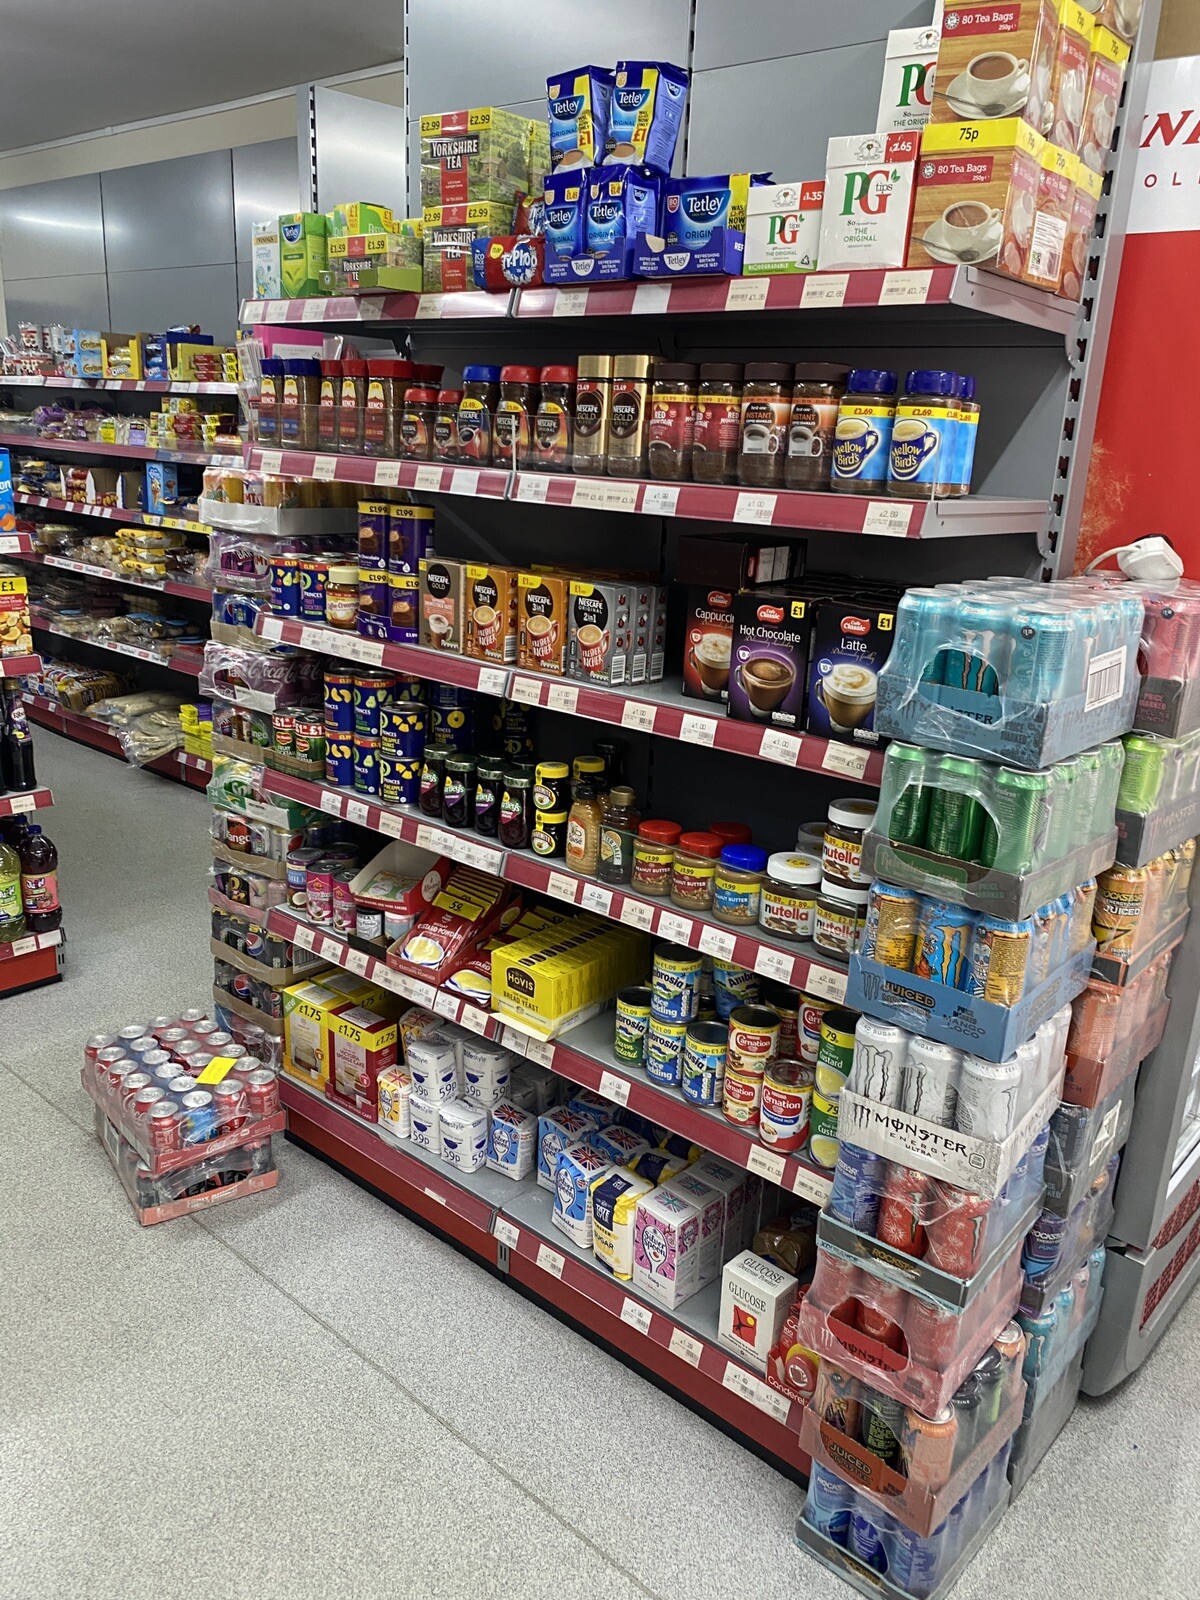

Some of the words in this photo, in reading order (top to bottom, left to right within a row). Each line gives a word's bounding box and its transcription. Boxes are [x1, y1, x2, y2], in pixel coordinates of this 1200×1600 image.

[961, 14, 974, 25] 80
[975, 13, 995, 24] Tea
[996, 12, 1014, 24] Bags
[618, 91, 645, 107] Tetley
[553, 99, 580, 115] Tetley
[421, 120, 441, 132] £2.99
[469, 113, 490, 126] £2.99
[893, 119, 906, 127] THE
[579, 130, 591, 147] £1
[633, 128, 647, 143] £1
[959, 126, 979, 142] 75p
[431, 138, 478, 157] YORKSHIRE
[446, 157, 463, 170] TEA
[1056, 152, 1066, 170] 75p
[937, 164, 949, 174] 80
[949, 163, 966, 174] Tea
[966, 162, 988, 174] Bags
[838, 170, 893, 216] PG
[875, 182, 893, 194] tips
[591, 204, 618, 218] Tetley
[687, 196, 724, 216] Tetley
[424, 212, 441, 223] £2.99
[468, 208, 488, 218] £2.99
[549, 209, 574, 225] Tetley
[728, 216, 745, 225] NOW
[588, 230, 619, 240] ORIGINAL
[685, 229, 714, 240] ORIGIN
[767, 214, 799, 245] PG
[854, 227, 868, 236] THE
[433, 231, 476, 245] YORKSHIRE
[843, 234, 877, 243] ORIGINAL
[330, 243, 346, 254] £1.59
[367, 240, 385, 251] £1.59
[446, 246, 461, 259] TEA
[342, 260, 372, 272] YORKSHIRE
[574, 260, 593, 273] Tetley
[666, 254, 688, 267] Tetley
[748, 262, 790, 272] BIODEGRADABLE
[577, 412, 597, 421] GOLD
[613, 413, 634, 422] GOLD
[654, 410, 666, 419] RED
[727, 411, 740, 419] RED
[853, 407, 873, 417] £2.69
[911, 408, 932, 417] £2.69
[835, 441, 864, 456] Mellow
[891, 444, 922, 459] Mellow
[837, 452, 860, 467] Bird's
[893, 453, 917, 468] Bird's
[369, 505, 388, 513] £1.99
[395, 508, 414, 517] £1.99
[368, 573, 387, 582] £1.99
[470, 568, 477, 577] £1
[1, 580, 16, 592] £1
[431, 583, 446, 591] GOLD
[522, 577, 529, 586] £1
[574, 585, 582, 594] £1
[478, 593, 491, 604] 3in1
[709, 596, 729, 606] Classic
[532, 602, 546, 613] 3in1
[578, 606, 603, 616] ORIGINAL
[792, 604, 804, 617] £1
[582, 612, 597, 623] 2in1
[759, 611, 782, 622] Classic
[879, 615, 892, 628] £1
[739, 624, 756, 637] Hot
[756, 626, 801, 644] Chocolate
[843, 622, 867, 633] Classic
[841, 636, 868, 652] Latte
[308, 724, 322, 736] £1
[691, 722, 707, 732] £1.00
[773, 739, 789, 749] £1.00
[846, 759, 865, 771] £1.00
[228, 831, 251, 843] ango
[841, 840, 861, 852] £2.89
[644, 854, 660, 863] £1.99
[823, 845, 861, 867] nutella
[653, 866, 671, 874] BUTTER
[680, 866, 695, 876] £1.99
[686, 879, 706, 888] BUTTER
[721, 881, 736, 891] £1.99
[728, 895, 749, 904] BUTTER
[764, 892, 782, 903] £2.89
[788, 896, 807, 908] £2.89
[764, 902, 810, 923] nutella
[1103, 904, 1141, 916] JUICED
[815, 917, 861, 940] nutella
[660, 961, 677, 971] £1.09
[880, 980, 936, 1009] JUICED
[285, 999, 296, 1013] NEW
[503, 990, 521, 1004] BREAD
[521, 1000, 539, 1013] YEAST
[299, 1004, 322, 1022] £1.75
[622, 1007, 638, 1016] £1.09
[655, 1025, 672, 1035] £1.09
[943, 1013, 987, 1036] MANGO
[338, 1024, 362, 1042] £1.75
[375, 1030, 395, 1047] £1.75
[872, 1028, 898, 1038] SUGAR
[735, 1034, 771, 1048] Carnation
[819, 1050, 844, 1069] Custard
[413, 1082, 429, 1098] 59p
[439, 1081, 457, 1099] 59p
[465, 1082, 481, 1098] 59p
[492, 1084, 509, 1100] 59p
[723, 1078, 755, 1098] Carnation
[763, 1086, 801, 1110] Carnation
[783, 1117, 795, 1125] milk
[412, 1130, 430, 1146] 59p
[889, 1132, 949, 1159] ENERGY
[904, 1143, 933, 1158] ULTRA
[443, 1147, 461, 1163] 59p
[595, 1203, 611, 1216] TATE
[644, 1230, 667, 1249] Silver
[643, 1239, 666, 1257] Spoon
[743, 1256, 786, 1285] GLUCOSE
[728, 1280, 767, 1313] GLUCOSE
[767, 1374, 809, 1407] Canderel
[828, 1442, 873, 1476] JUICED
